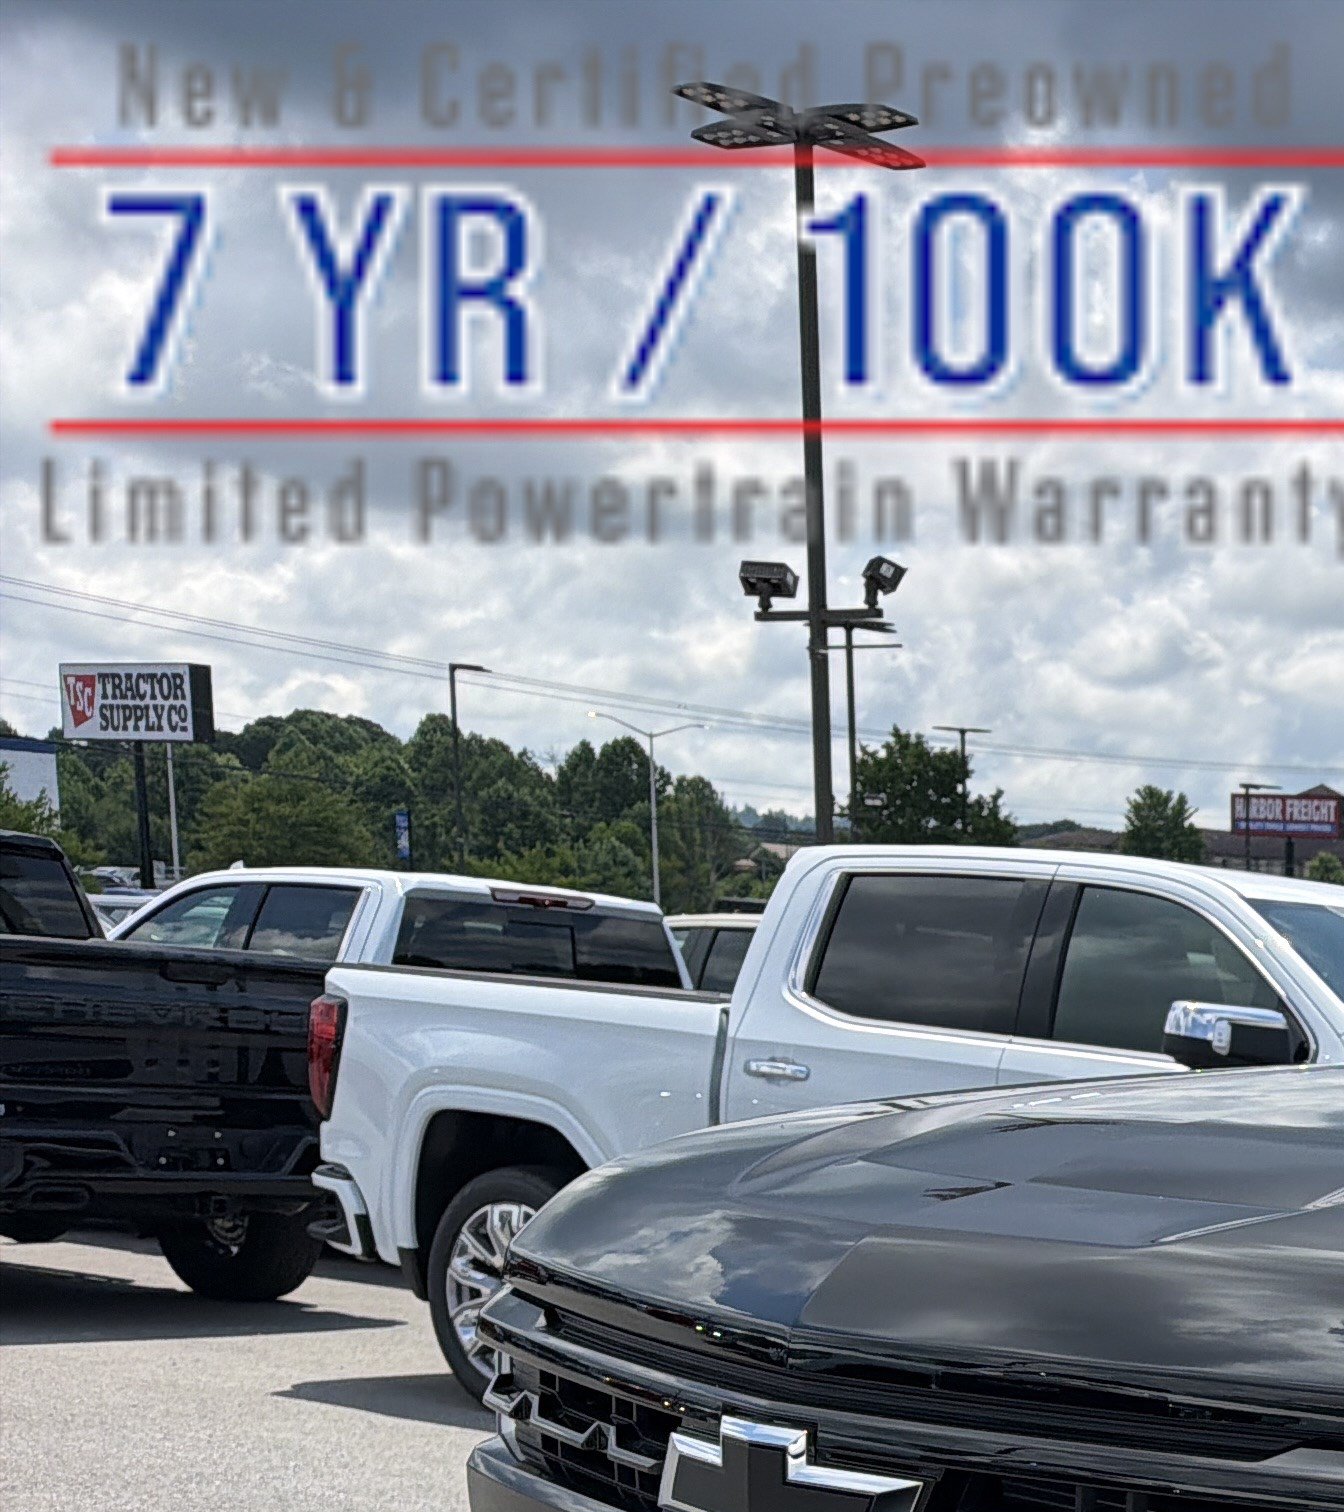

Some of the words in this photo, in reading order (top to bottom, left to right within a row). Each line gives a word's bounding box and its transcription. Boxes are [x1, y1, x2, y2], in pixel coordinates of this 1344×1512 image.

[65, 676, 93, 718] TSC
[97, 672, 187, 702] TRACTOR
[99, 703, 166, 733] SUPPLY
[1284, 798, 1338, 823] FREIGHT
